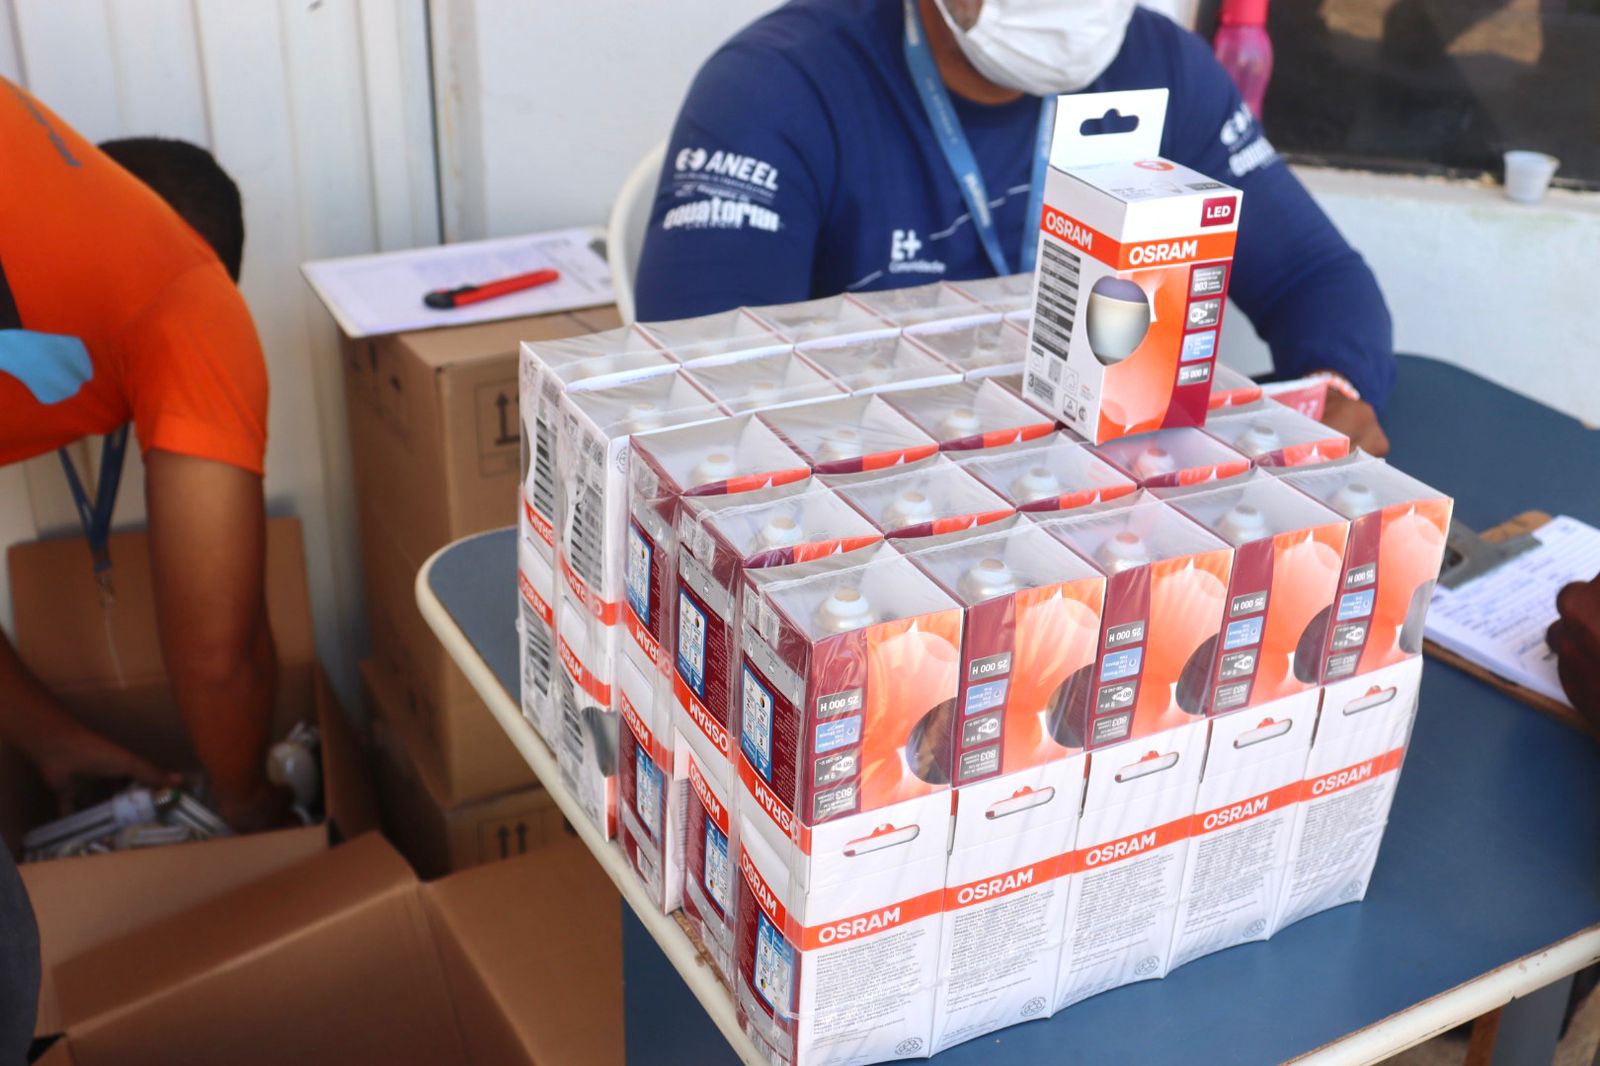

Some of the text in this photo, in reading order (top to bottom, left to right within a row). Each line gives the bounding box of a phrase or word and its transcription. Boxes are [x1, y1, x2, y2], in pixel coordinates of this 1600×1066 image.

[705, 150, 778, 191] ANEEL
[1206, 204, 1232, 220] LED
[1046, 211, 1093, 250] OSRAM
[1128, 240, 1198, 265] OSRAM
[1109, 628, 1142, 643] 25 000 H
[972, 660, 1008, 675] 25 000 H
[820, 696, 859, 712] 25 000 H
[689, 697, 729, 752] OSRAM
[690, 762, 720, 820] OSRAM
[834, 787, 853, 800] 803
[1312, 762, 1372, 795] OSRAM
[1203, 797, 1268, 830] OSRAM
[1085, 832, 1156, 865] OSRAM
[742, 853, 777, 917] OSRAM
[958, 868, 1034, 904] OSRAM
[818, 907, 901, 943] OSRAM
